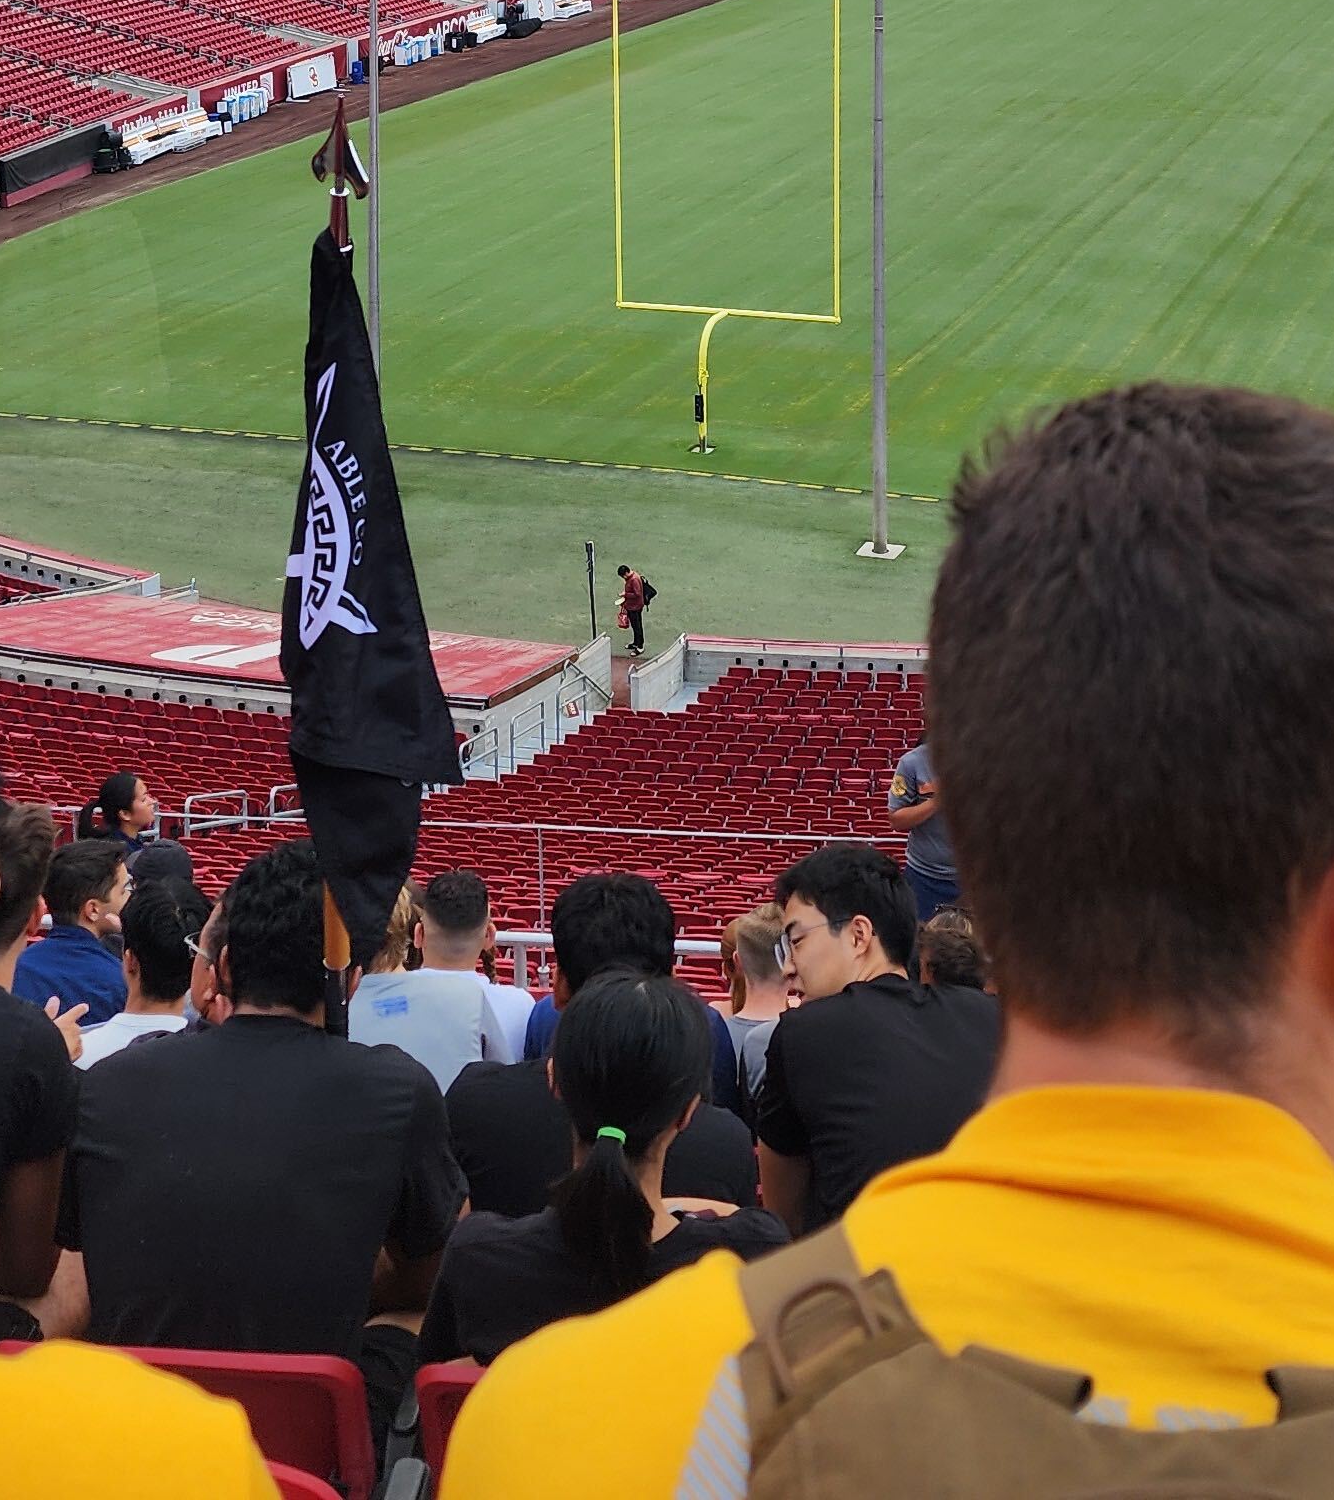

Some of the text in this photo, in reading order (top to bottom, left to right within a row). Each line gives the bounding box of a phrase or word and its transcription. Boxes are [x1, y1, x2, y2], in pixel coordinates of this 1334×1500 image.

[223, 80, 259, 99] UNITED
[323, 439, 368, 566] ABLE CO
